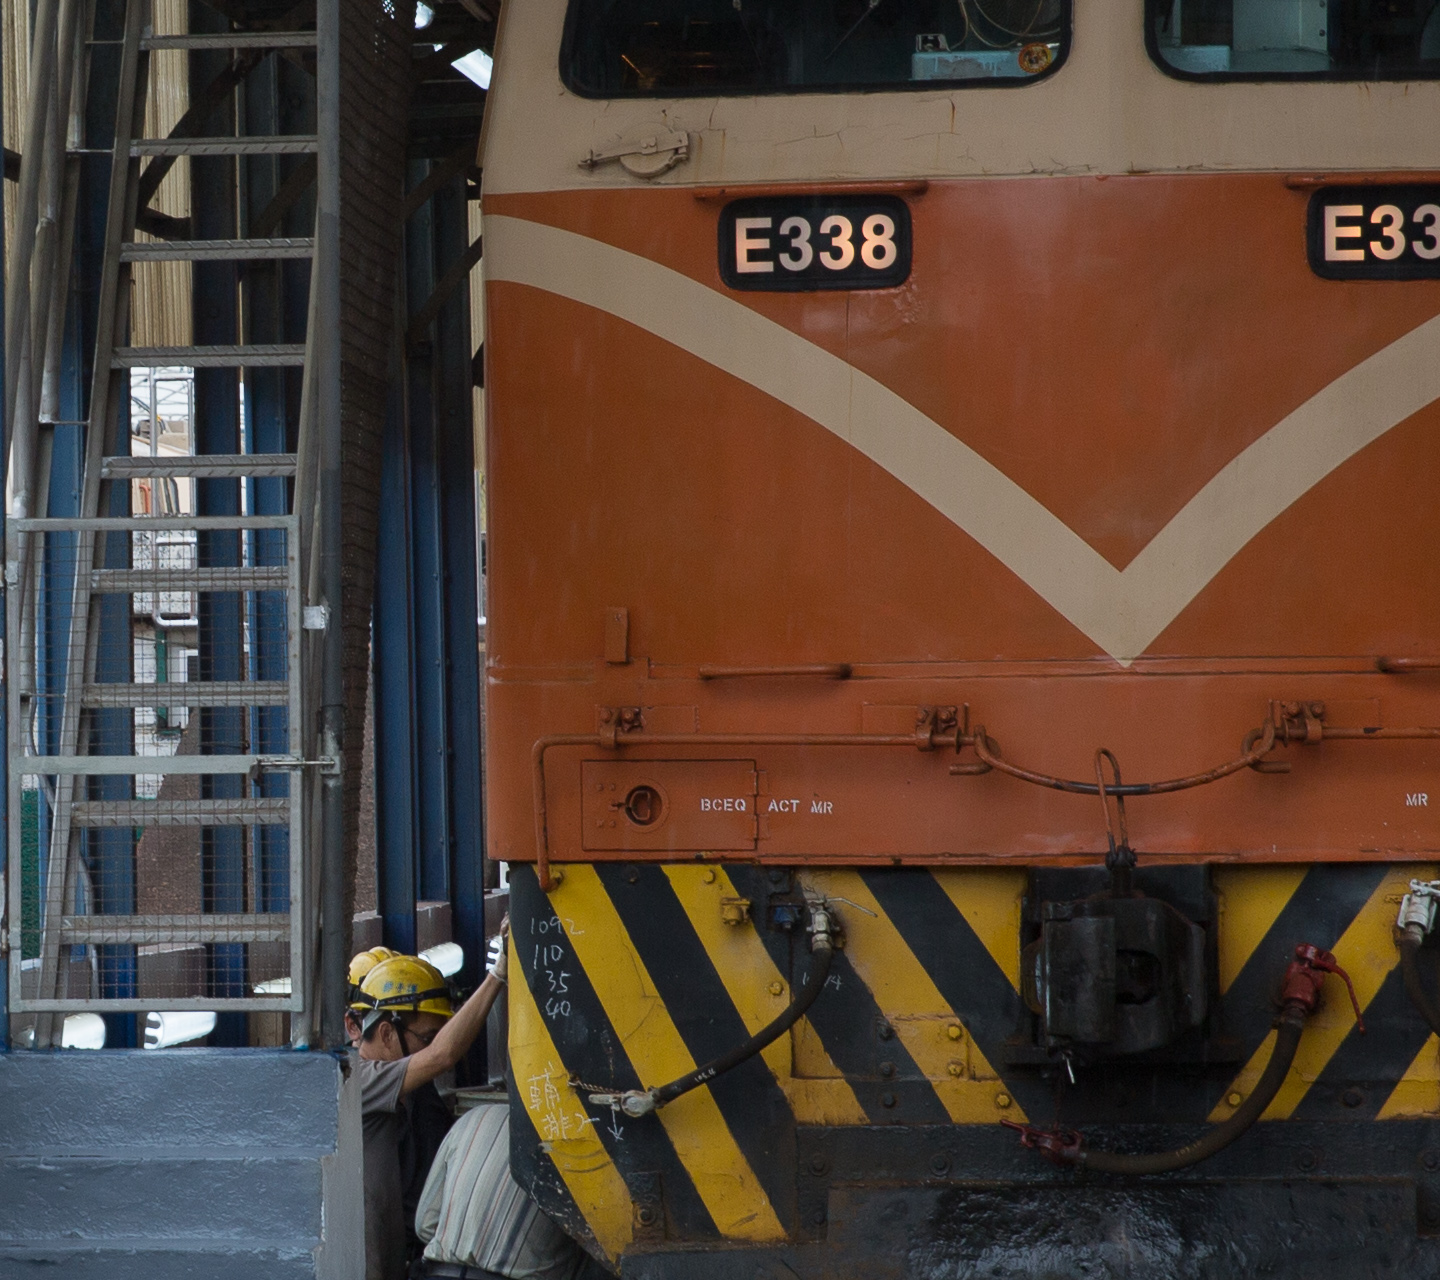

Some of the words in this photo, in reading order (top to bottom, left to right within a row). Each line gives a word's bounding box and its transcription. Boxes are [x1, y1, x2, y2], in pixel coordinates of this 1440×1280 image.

[736, 214, 897, 273] E338
[700, 798, 746, 812] BCEQ
[768, 799, 800, 813] ACT
[810, 800, 834, 815] MR
[1406, 793, 1429, 807] MR
[531, 916, 585, 935] 1092
[533, 944, 564, 970] 110
[545, 970, 571, 994] 35
[545, 997, 571, 1020] 40
